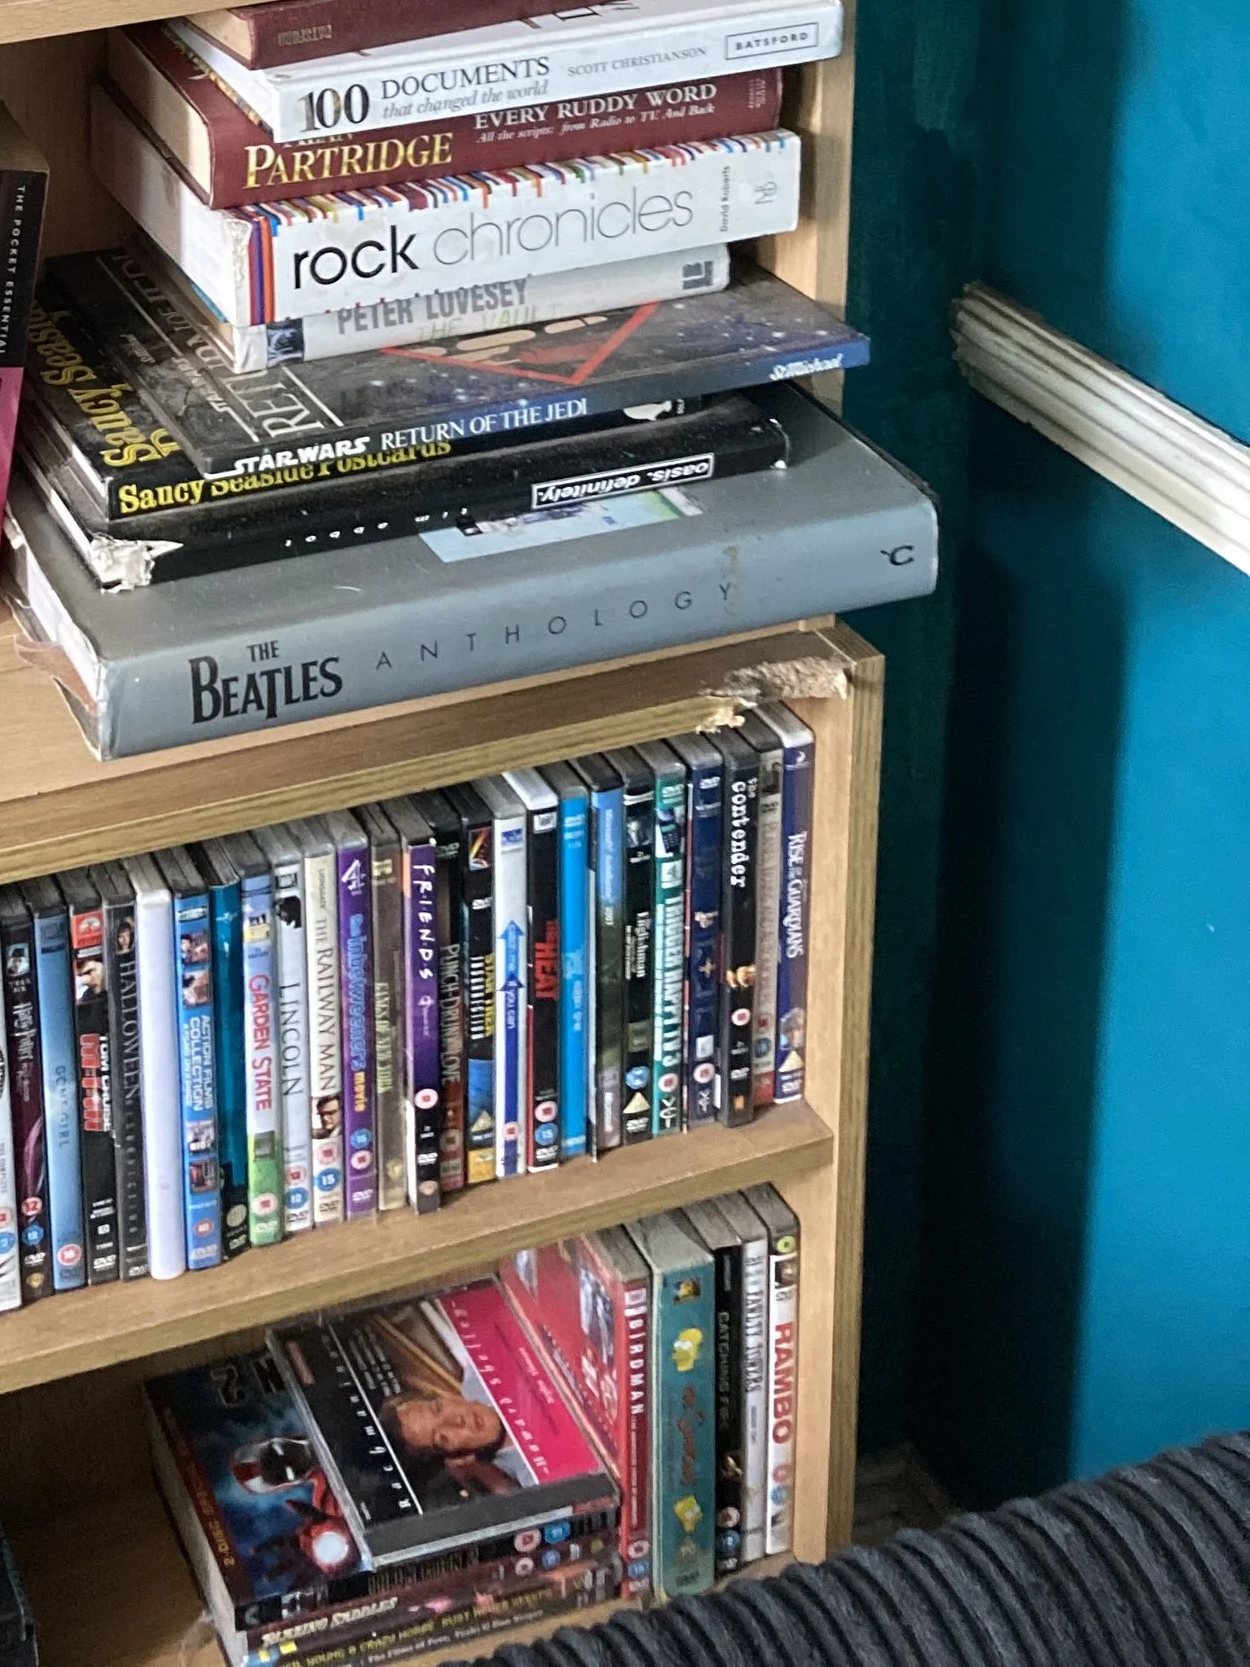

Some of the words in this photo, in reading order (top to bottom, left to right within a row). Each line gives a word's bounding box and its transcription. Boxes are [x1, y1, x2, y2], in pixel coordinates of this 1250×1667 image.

[298, 83, 370, 133] 100
[381, 55, 551, 101] DOCUMENTS
[566, 61, 610, 78] SCOTT
[611, 46, 708, 71] CHRISTIANSON
[480, 88, 504, 104] the
[242, 132, 454, 190] PARTRIDGE
[473, 103, 550, 131] EVERY
[556, 93, 639, 119] RUDDY
[645, 82, 719, 108] WORD
[7, 219, 23, 275] POCKET
[293, 224, 420, 290] rock
[433, 185, 694, 266] chronicles
[337, 298, 414, 336] PETER
[379, 420, 466, 453] RETURN
[117, 479, 205, 515] Saucy
[247, 639, 281, 663] THE
[188, 654, 345, 725] BEATLES
[315, 917, 330, 945] THE
[248, 974, 271, 1051] GARDEN
[316, 945, 336, 1041] RAILWAY
[190, 1016, 202, 1112] COLLECTION
[280, 982, 305, 1097] LINCOLN
[318, 1043, 337, 1093] MAN
[251, 1058, 274, 1112] STATE
[627, 1316, 648, 1416] BIRDMAN
[771, 1320, 796, 1446] RAMBO
